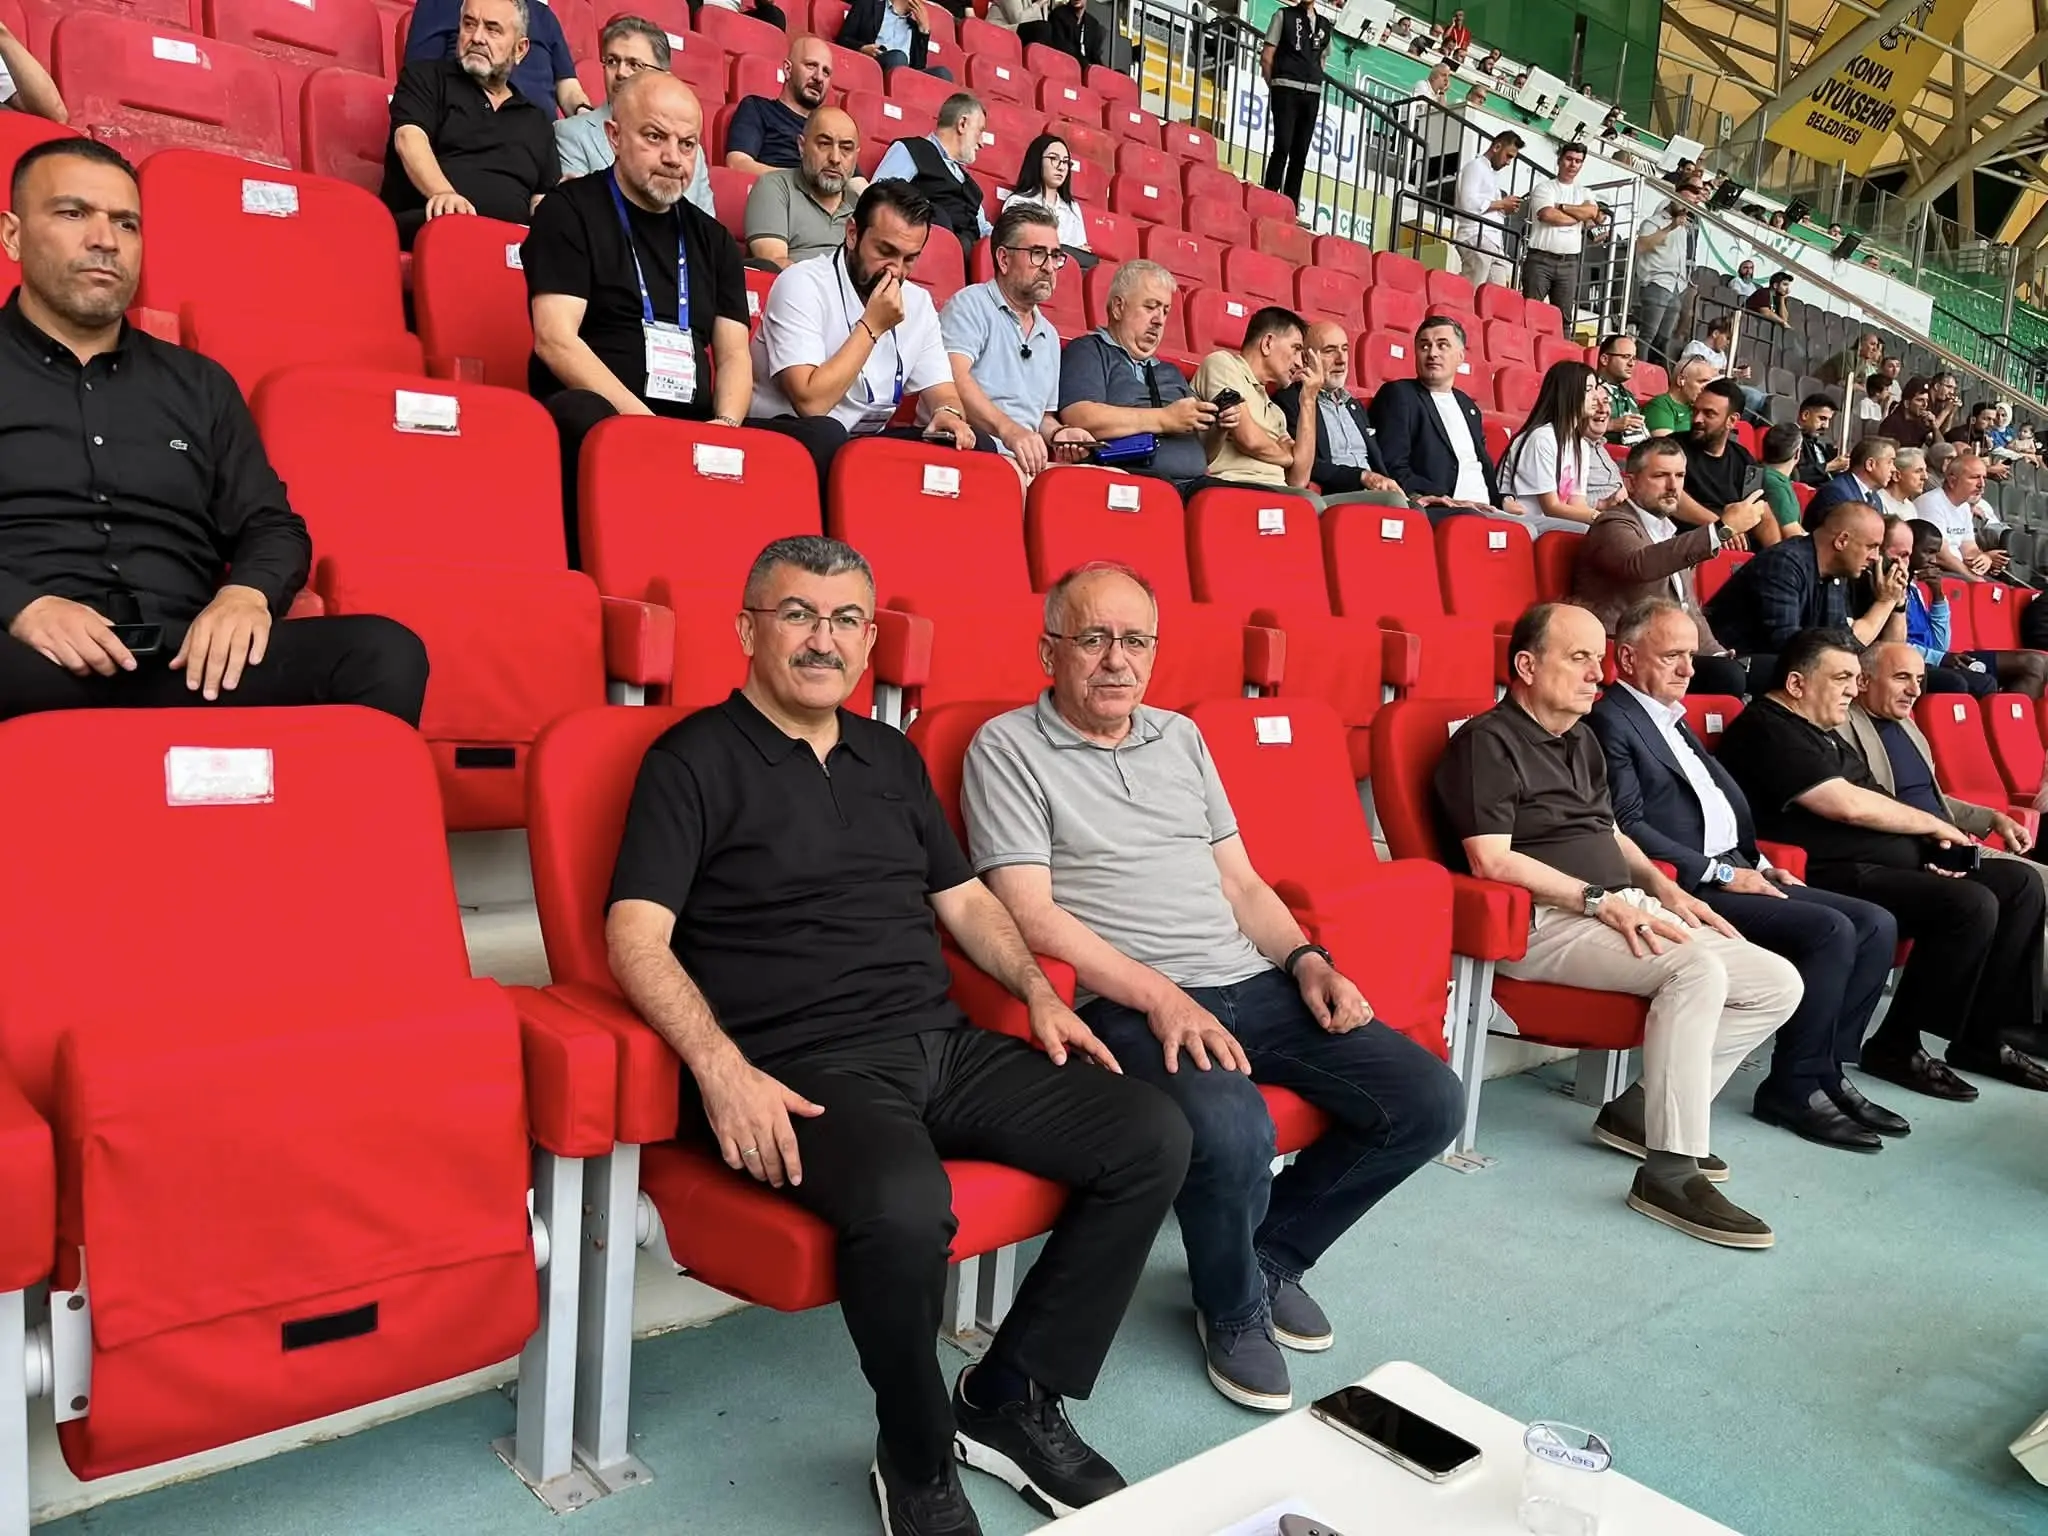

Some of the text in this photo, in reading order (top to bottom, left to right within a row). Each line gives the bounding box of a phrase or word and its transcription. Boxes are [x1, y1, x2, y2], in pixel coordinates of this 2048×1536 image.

[1844, 54, 1894, 92] KONYA
[1239, 89, 1355, 163] BSU
[1805, 110, 1866, 146] BELEDİYESİ
